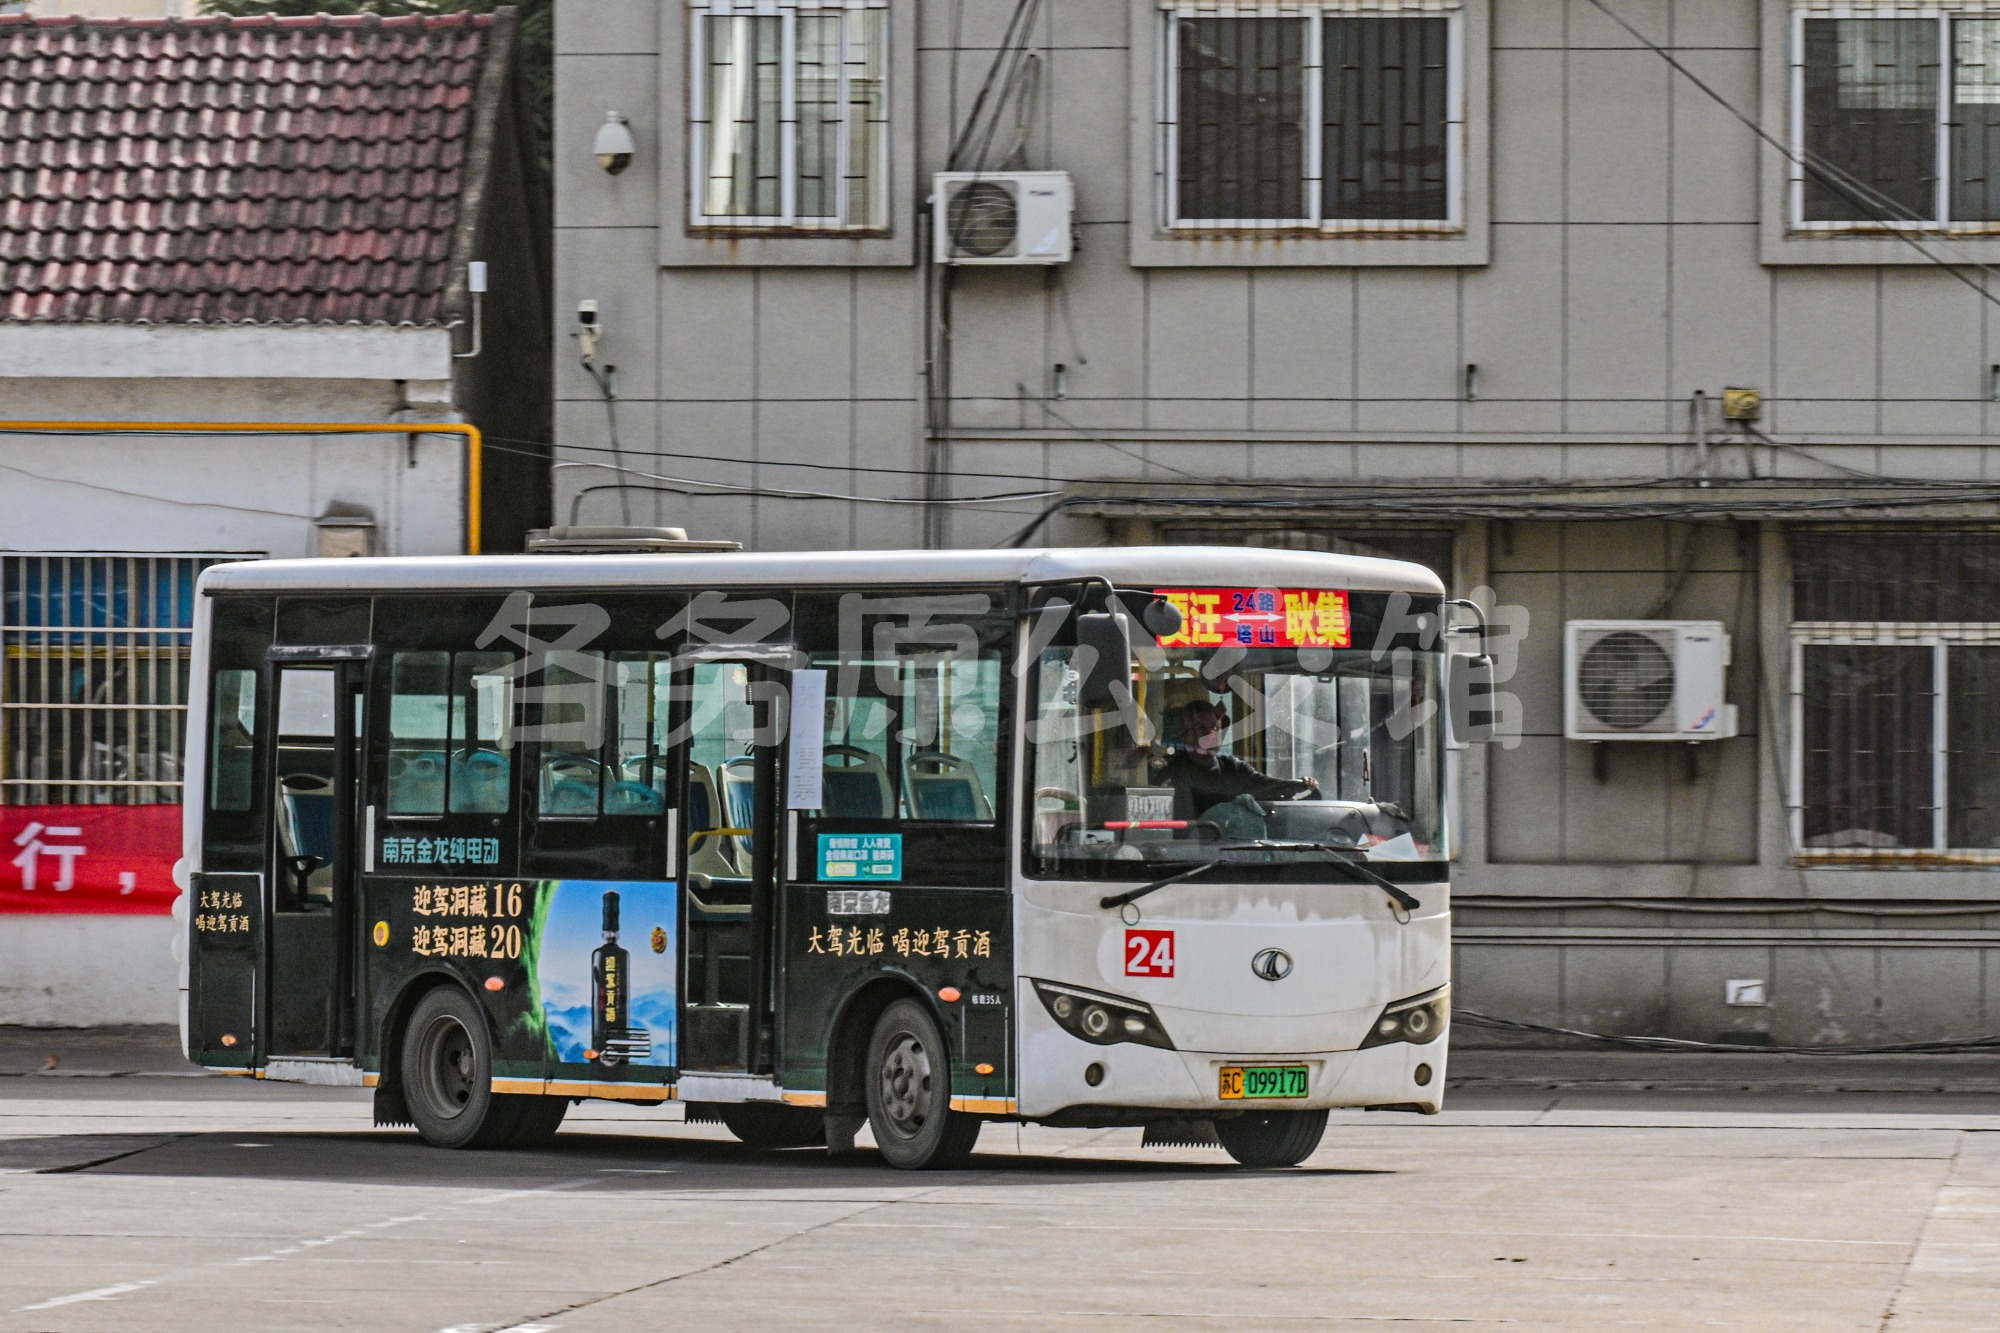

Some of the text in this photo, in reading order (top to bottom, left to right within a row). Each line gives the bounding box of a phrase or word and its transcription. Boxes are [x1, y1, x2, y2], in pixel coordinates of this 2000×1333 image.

[1232, 592, 1275, 612] 24路
[1284, 591, 1347, 646] 耿集
[1236, 624, 1275, 645] 塔山
[383, 837, 499, 864] 南京金龙纯电动
[200, 890, 243, 909] 大驾光临
[195, 913, 249, 932] 喝迎驾贡酒
[808, 926, 991, 958] 大驾光临 喝迎驾贡酒
[1127, 936, 1174, 974] 24
